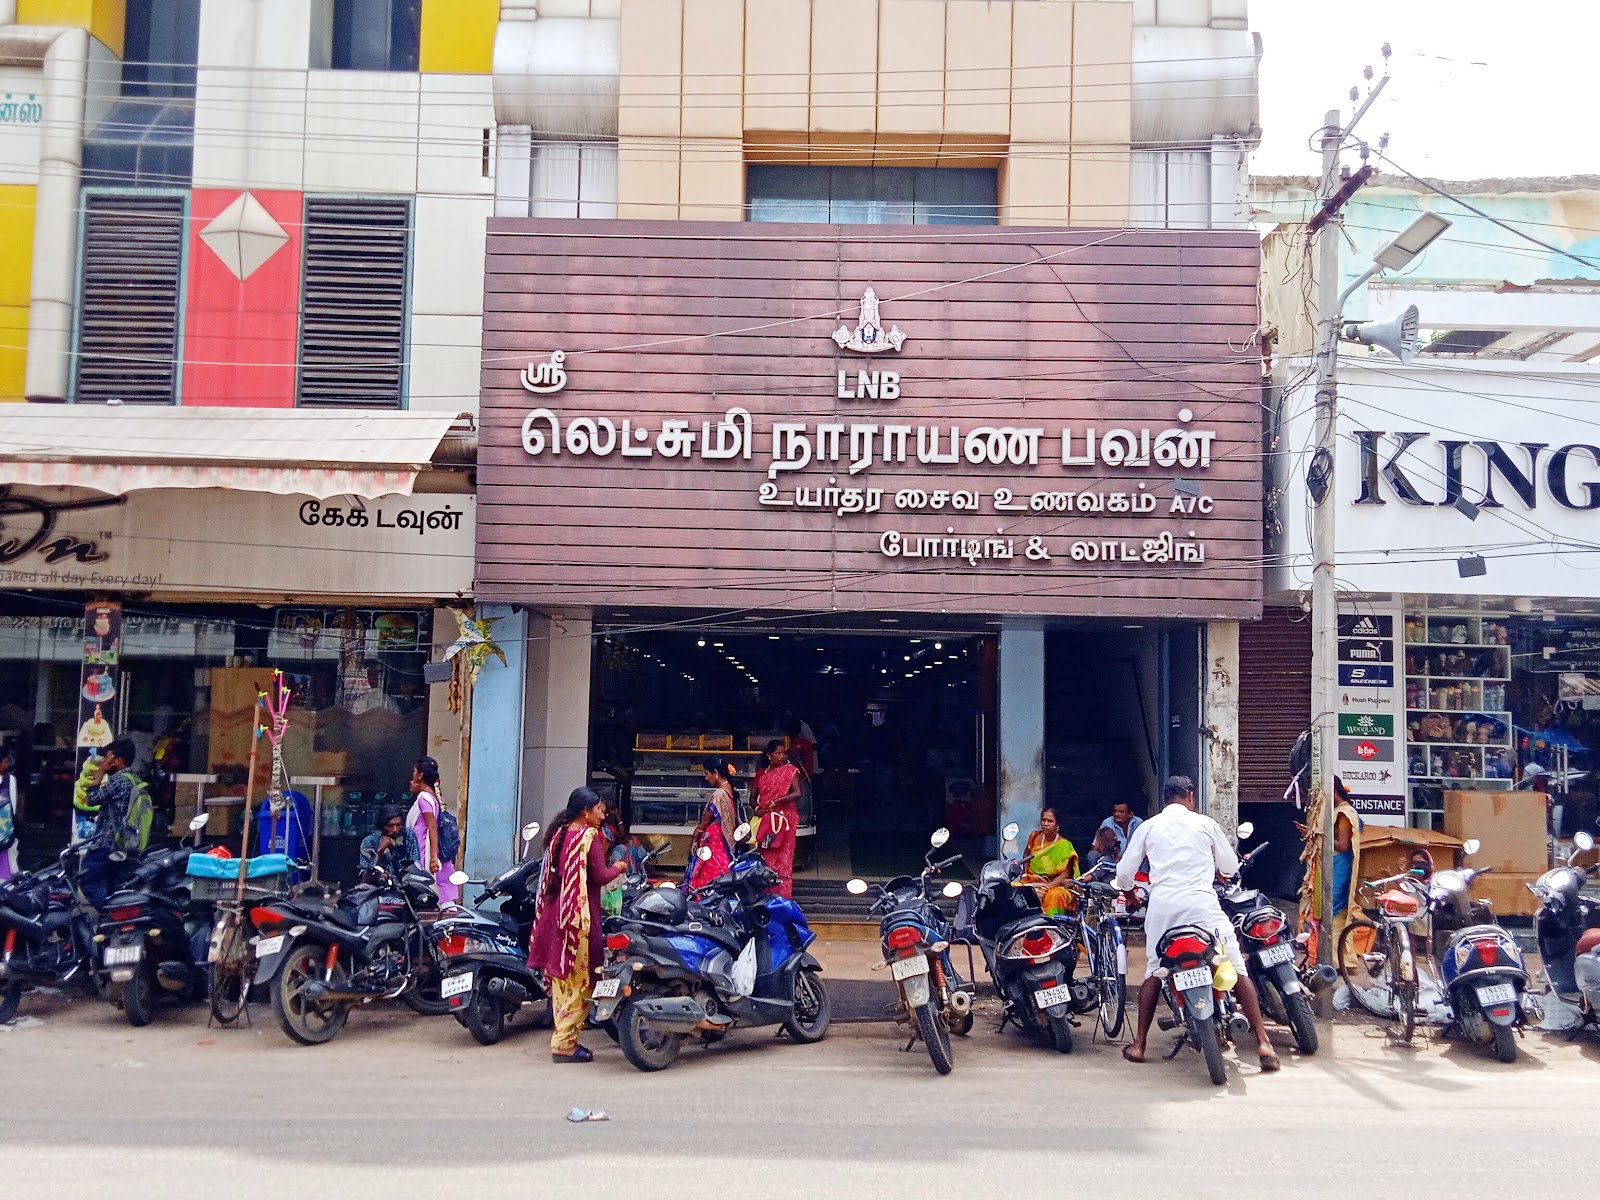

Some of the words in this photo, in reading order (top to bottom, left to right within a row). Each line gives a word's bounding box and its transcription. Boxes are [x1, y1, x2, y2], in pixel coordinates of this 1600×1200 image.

[838, 369, 901, 400] LNB
[521, 407, 753, 460] லெட்சுமி
[768, 422, 1044, 479] நாராயண
[1061, 408, 1216, 468] பவன்
[1351, 430, 1600, 511] KING
[759, 477, 884, 517] உயர்தர
[895, 487, 980, 511] சைவ
[993, 482, 1157, 514] உணவகம்
[1169, 495, 1214, 514] A/C
[376, 504, 463, 535] டவுன்
[879, 526, 1013, 566] போர்டிங்
[1025, 536, 1052, 561] &
[1070, 529, 1206, 564] லாட்ஜிங்
[41, 571, 58, 583] all
[62, 572, 86, 586] day
[91, 572, 128, 587] Every
[132, 573, 162, 587] day!
[1352, 627, 1378, 635] adidas
[1350, 649, 1376, 659] PUMA
[1346, 725, 1386, 735] WOODLAND
[1342, 771, 1377, 780] BUCKAROO
